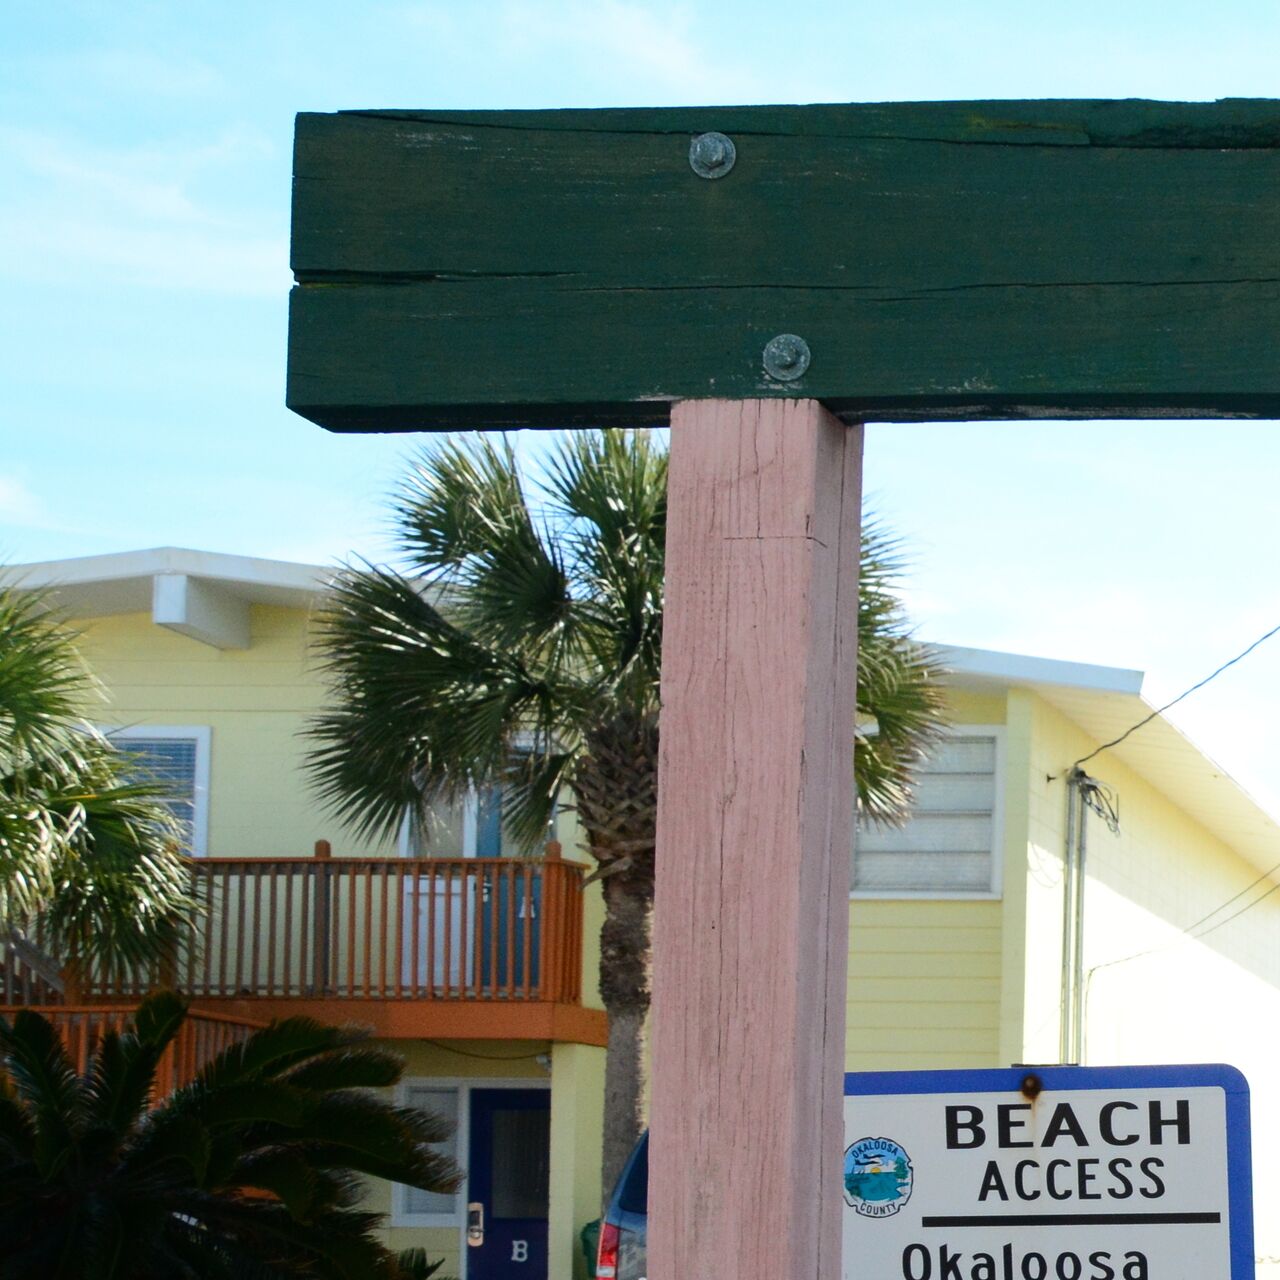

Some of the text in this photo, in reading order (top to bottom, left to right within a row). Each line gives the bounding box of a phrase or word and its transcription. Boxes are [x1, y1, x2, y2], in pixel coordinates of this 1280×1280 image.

[945, 1100, 1191, 1149] BEACH
[851, 1140, 899, 1158] OKALOOSA
[977, 1157, 1166, 1201] ACCESS
[860, 1202, 896, 1215] COUNTY
[511, 1239, 528, 1262] B
